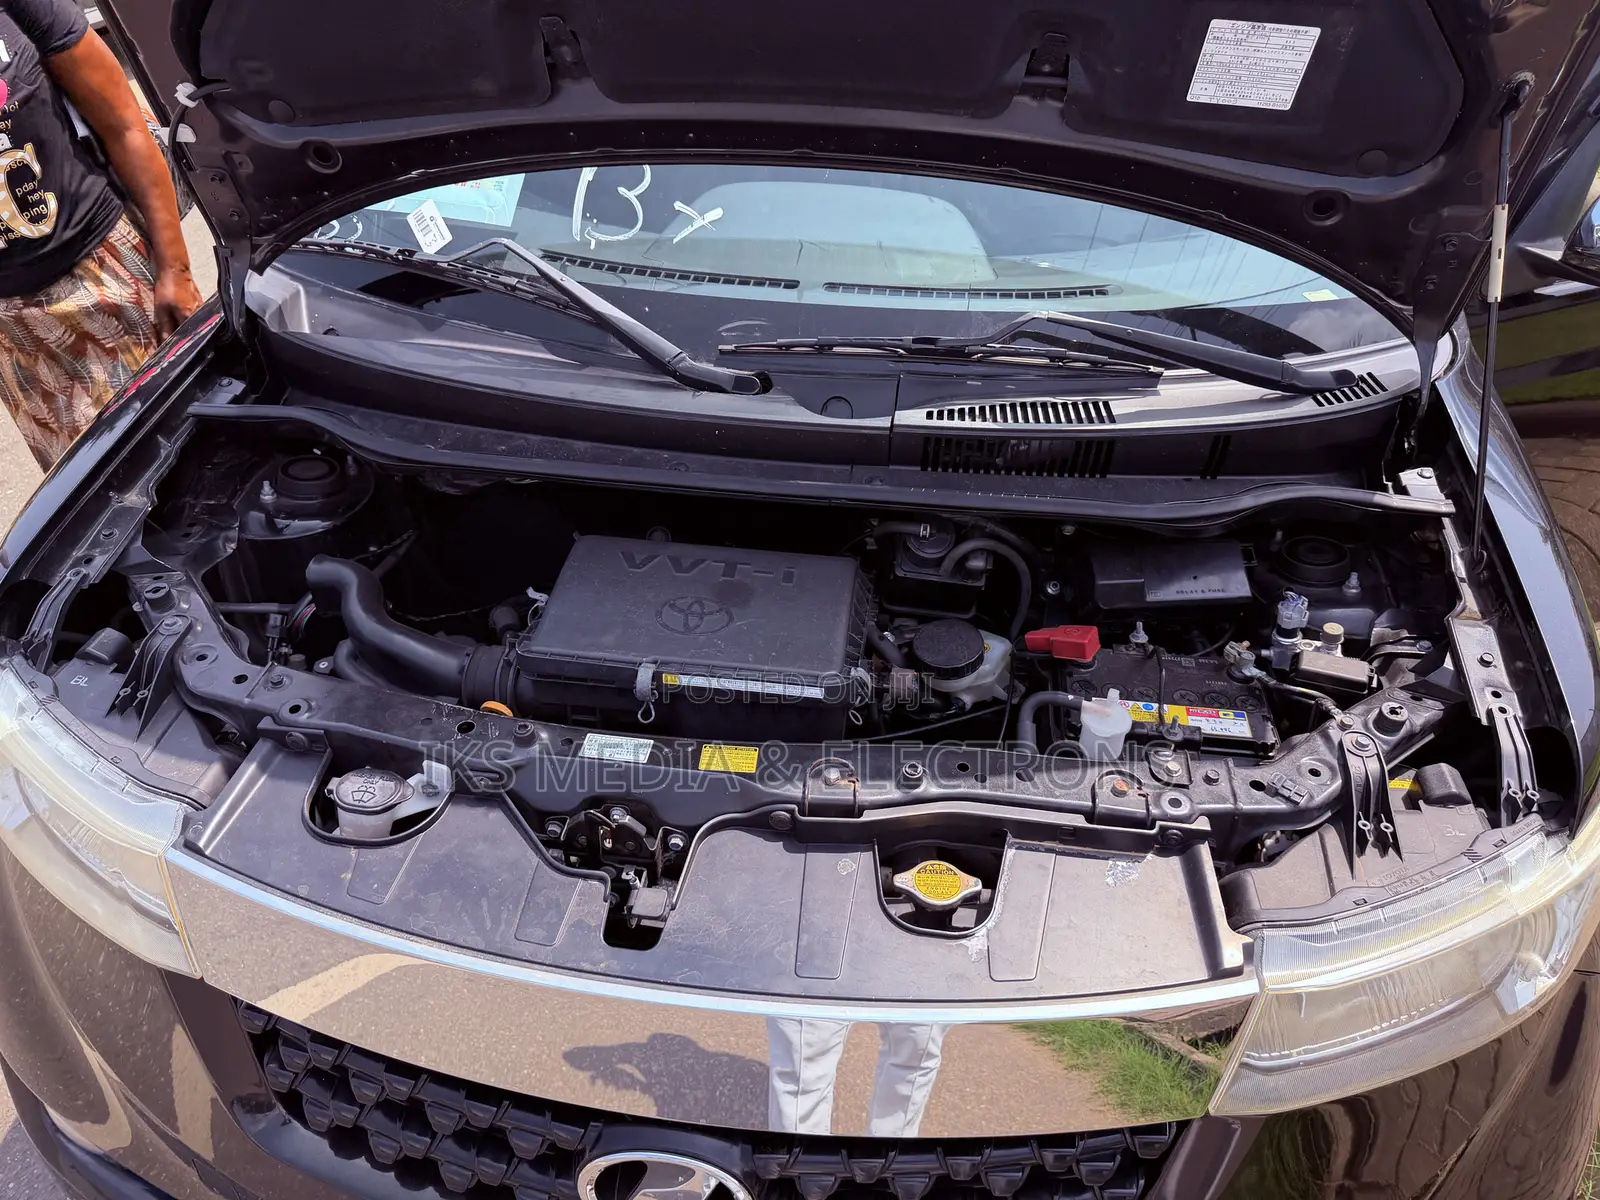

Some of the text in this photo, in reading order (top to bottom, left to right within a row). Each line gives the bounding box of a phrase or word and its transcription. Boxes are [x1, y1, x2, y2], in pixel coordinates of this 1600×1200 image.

[15, 179, 38, 197] pday
[27, 189, 45, 203] hey
[22, 204, 48, 220] ping
[70, 675, 89, 687] BL
